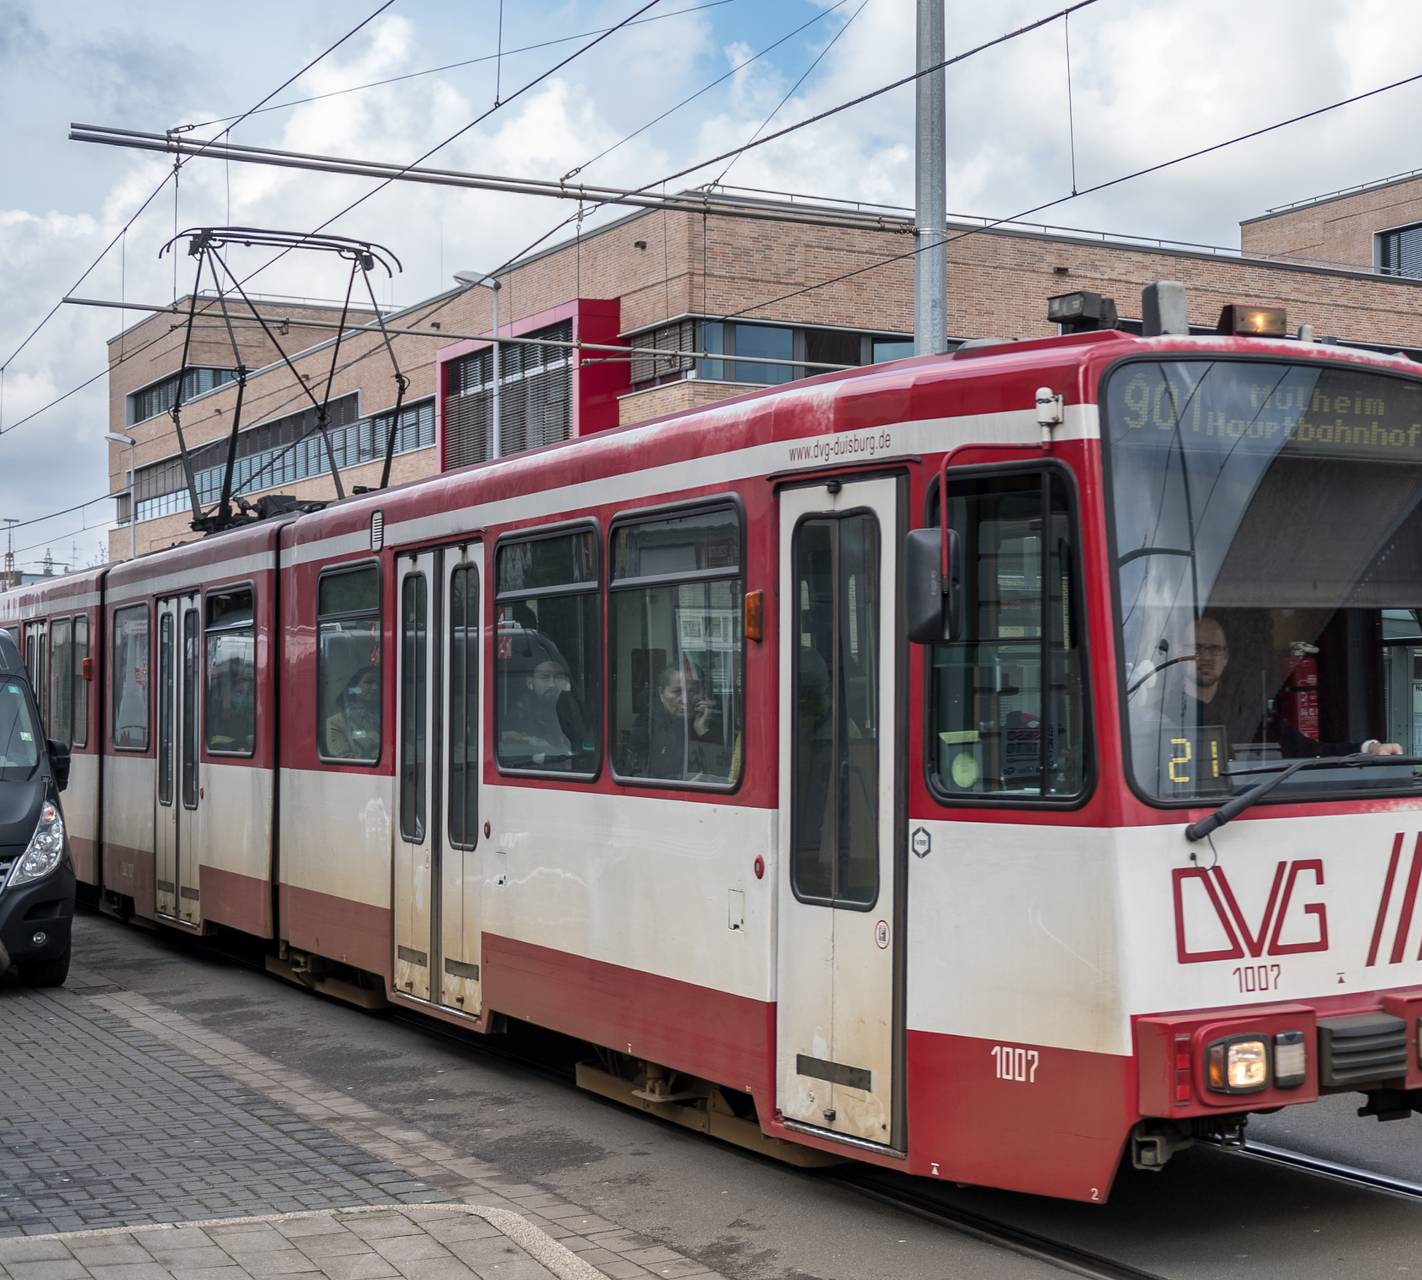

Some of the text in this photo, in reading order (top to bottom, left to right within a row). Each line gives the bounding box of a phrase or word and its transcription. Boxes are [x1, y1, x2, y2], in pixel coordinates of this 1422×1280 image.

[1123, 373, 1201, 432] 901
[788, 430, 893, 462] www.dvg-duisburg.de
[1207, 411, 1421, 447] Hauptbahnhof
[1171, 858, 1329, 964] DVG
[1232, 963, 1281, 993] 1007
[991, 1045, 1039, 1083] 1007
[1091, 1187, 1099, 1200] 2
